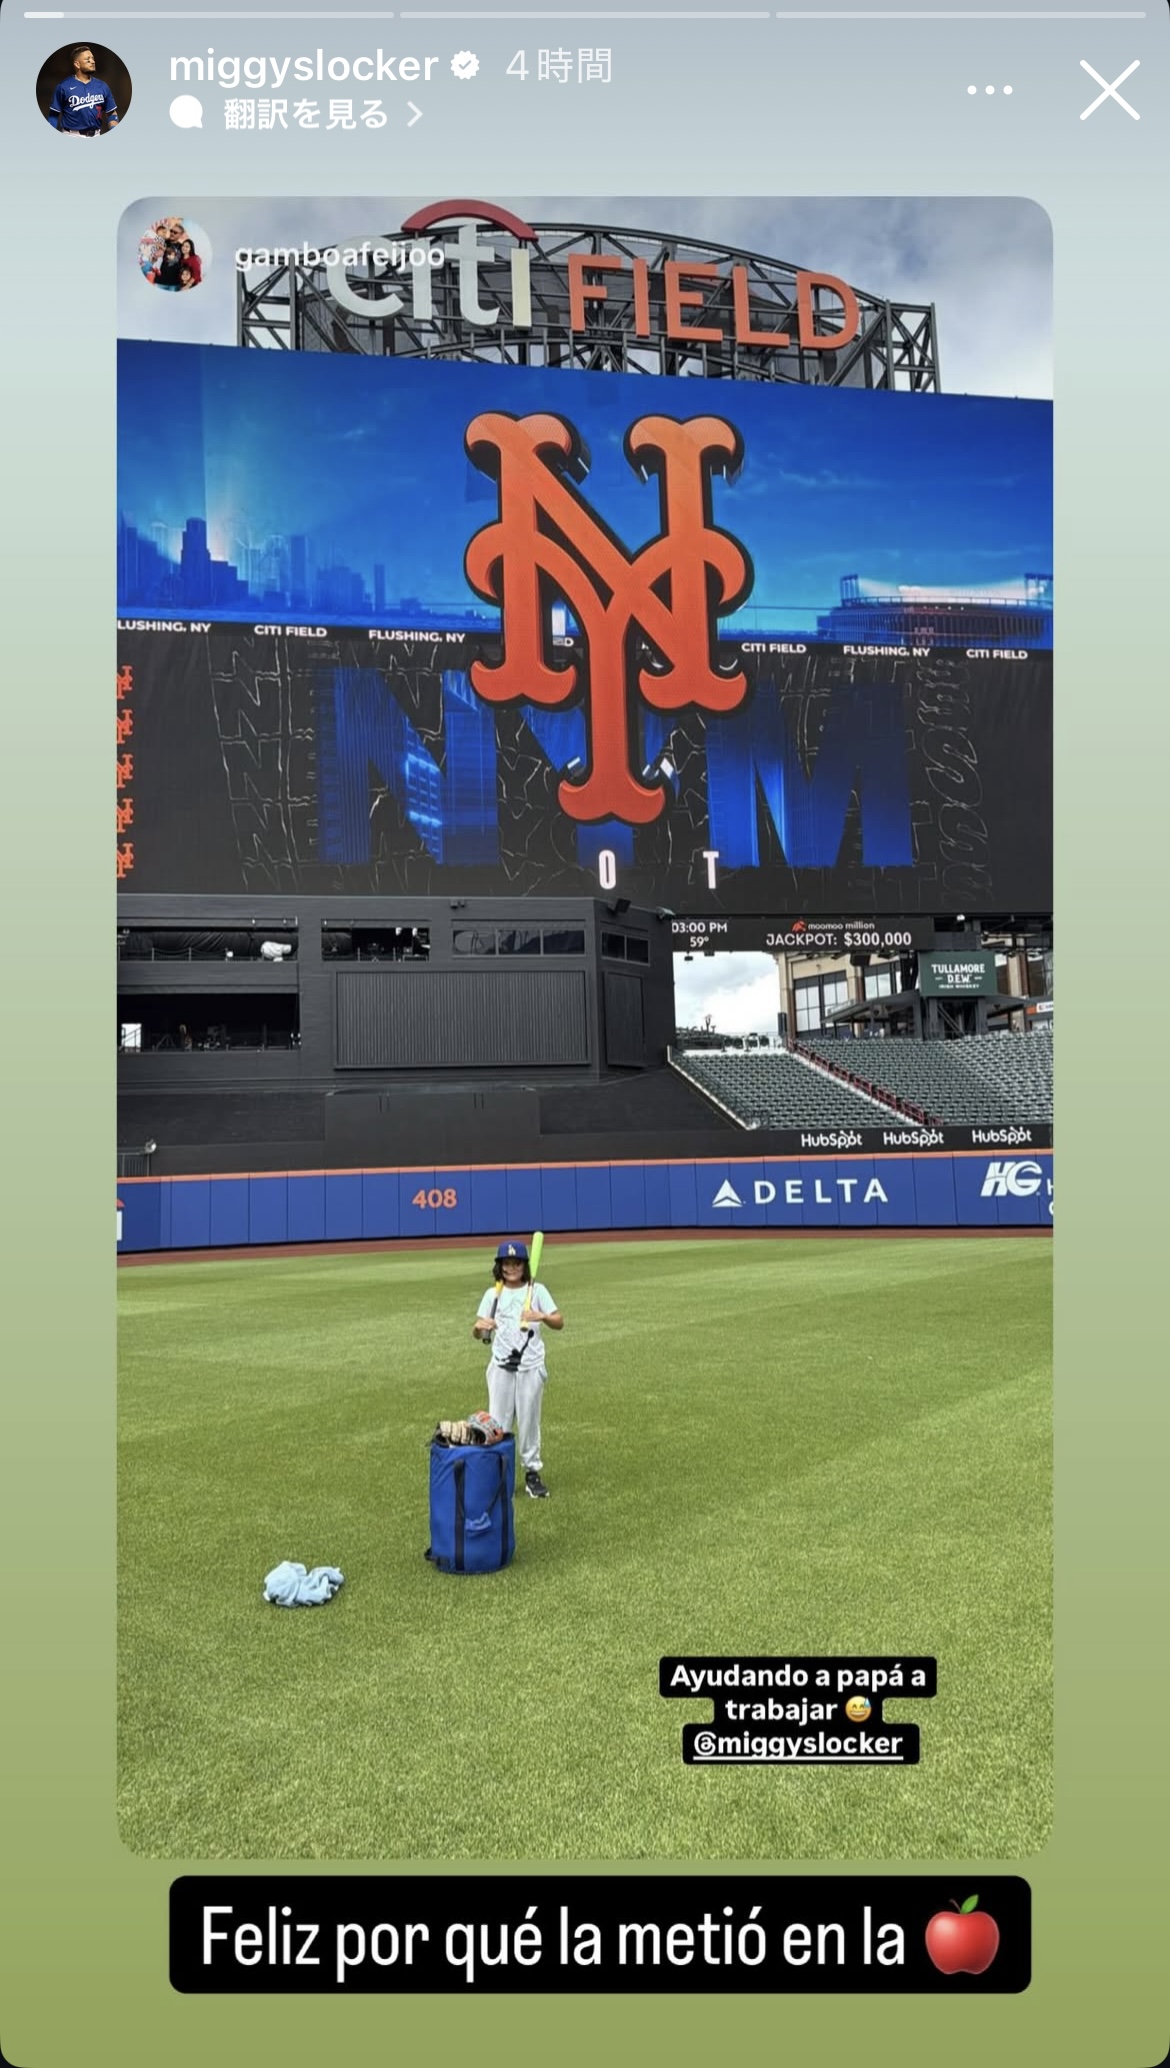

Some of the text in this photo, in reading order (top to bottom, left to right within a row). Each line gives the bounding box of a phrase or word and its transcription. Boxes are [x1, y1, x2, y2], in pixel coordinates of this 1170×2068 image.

[327, 222, 860, 351] citi FIELD
[190, 622, 211, 633] NY
[254, 625, 328, 637] CITI FIELD
[446, 632, 465, 644] NY
[741, 642, 807, 654] CITI FIELD
[912, 647, 930, 658] NY
[966, 649, 1028, 660] CITI FIELD
[672, 922, 728, 933] 03:00 PM
[845, 921, 875, 930] million
[690, 935, 709, 947] 59°
[766, 931, 912, 947] JACKPOT: $300,000
[931, 963, 985, 974] TULLAMORE
[801, 1130, 862, 1148] HubSpot
[883, 1128, 944, 1146] HubSpot
[972, 1126, 1032, 1144] HubSpot
[755, 1178, 888, 1205] DELTA
[412, 1188, 457, 1209] 408
